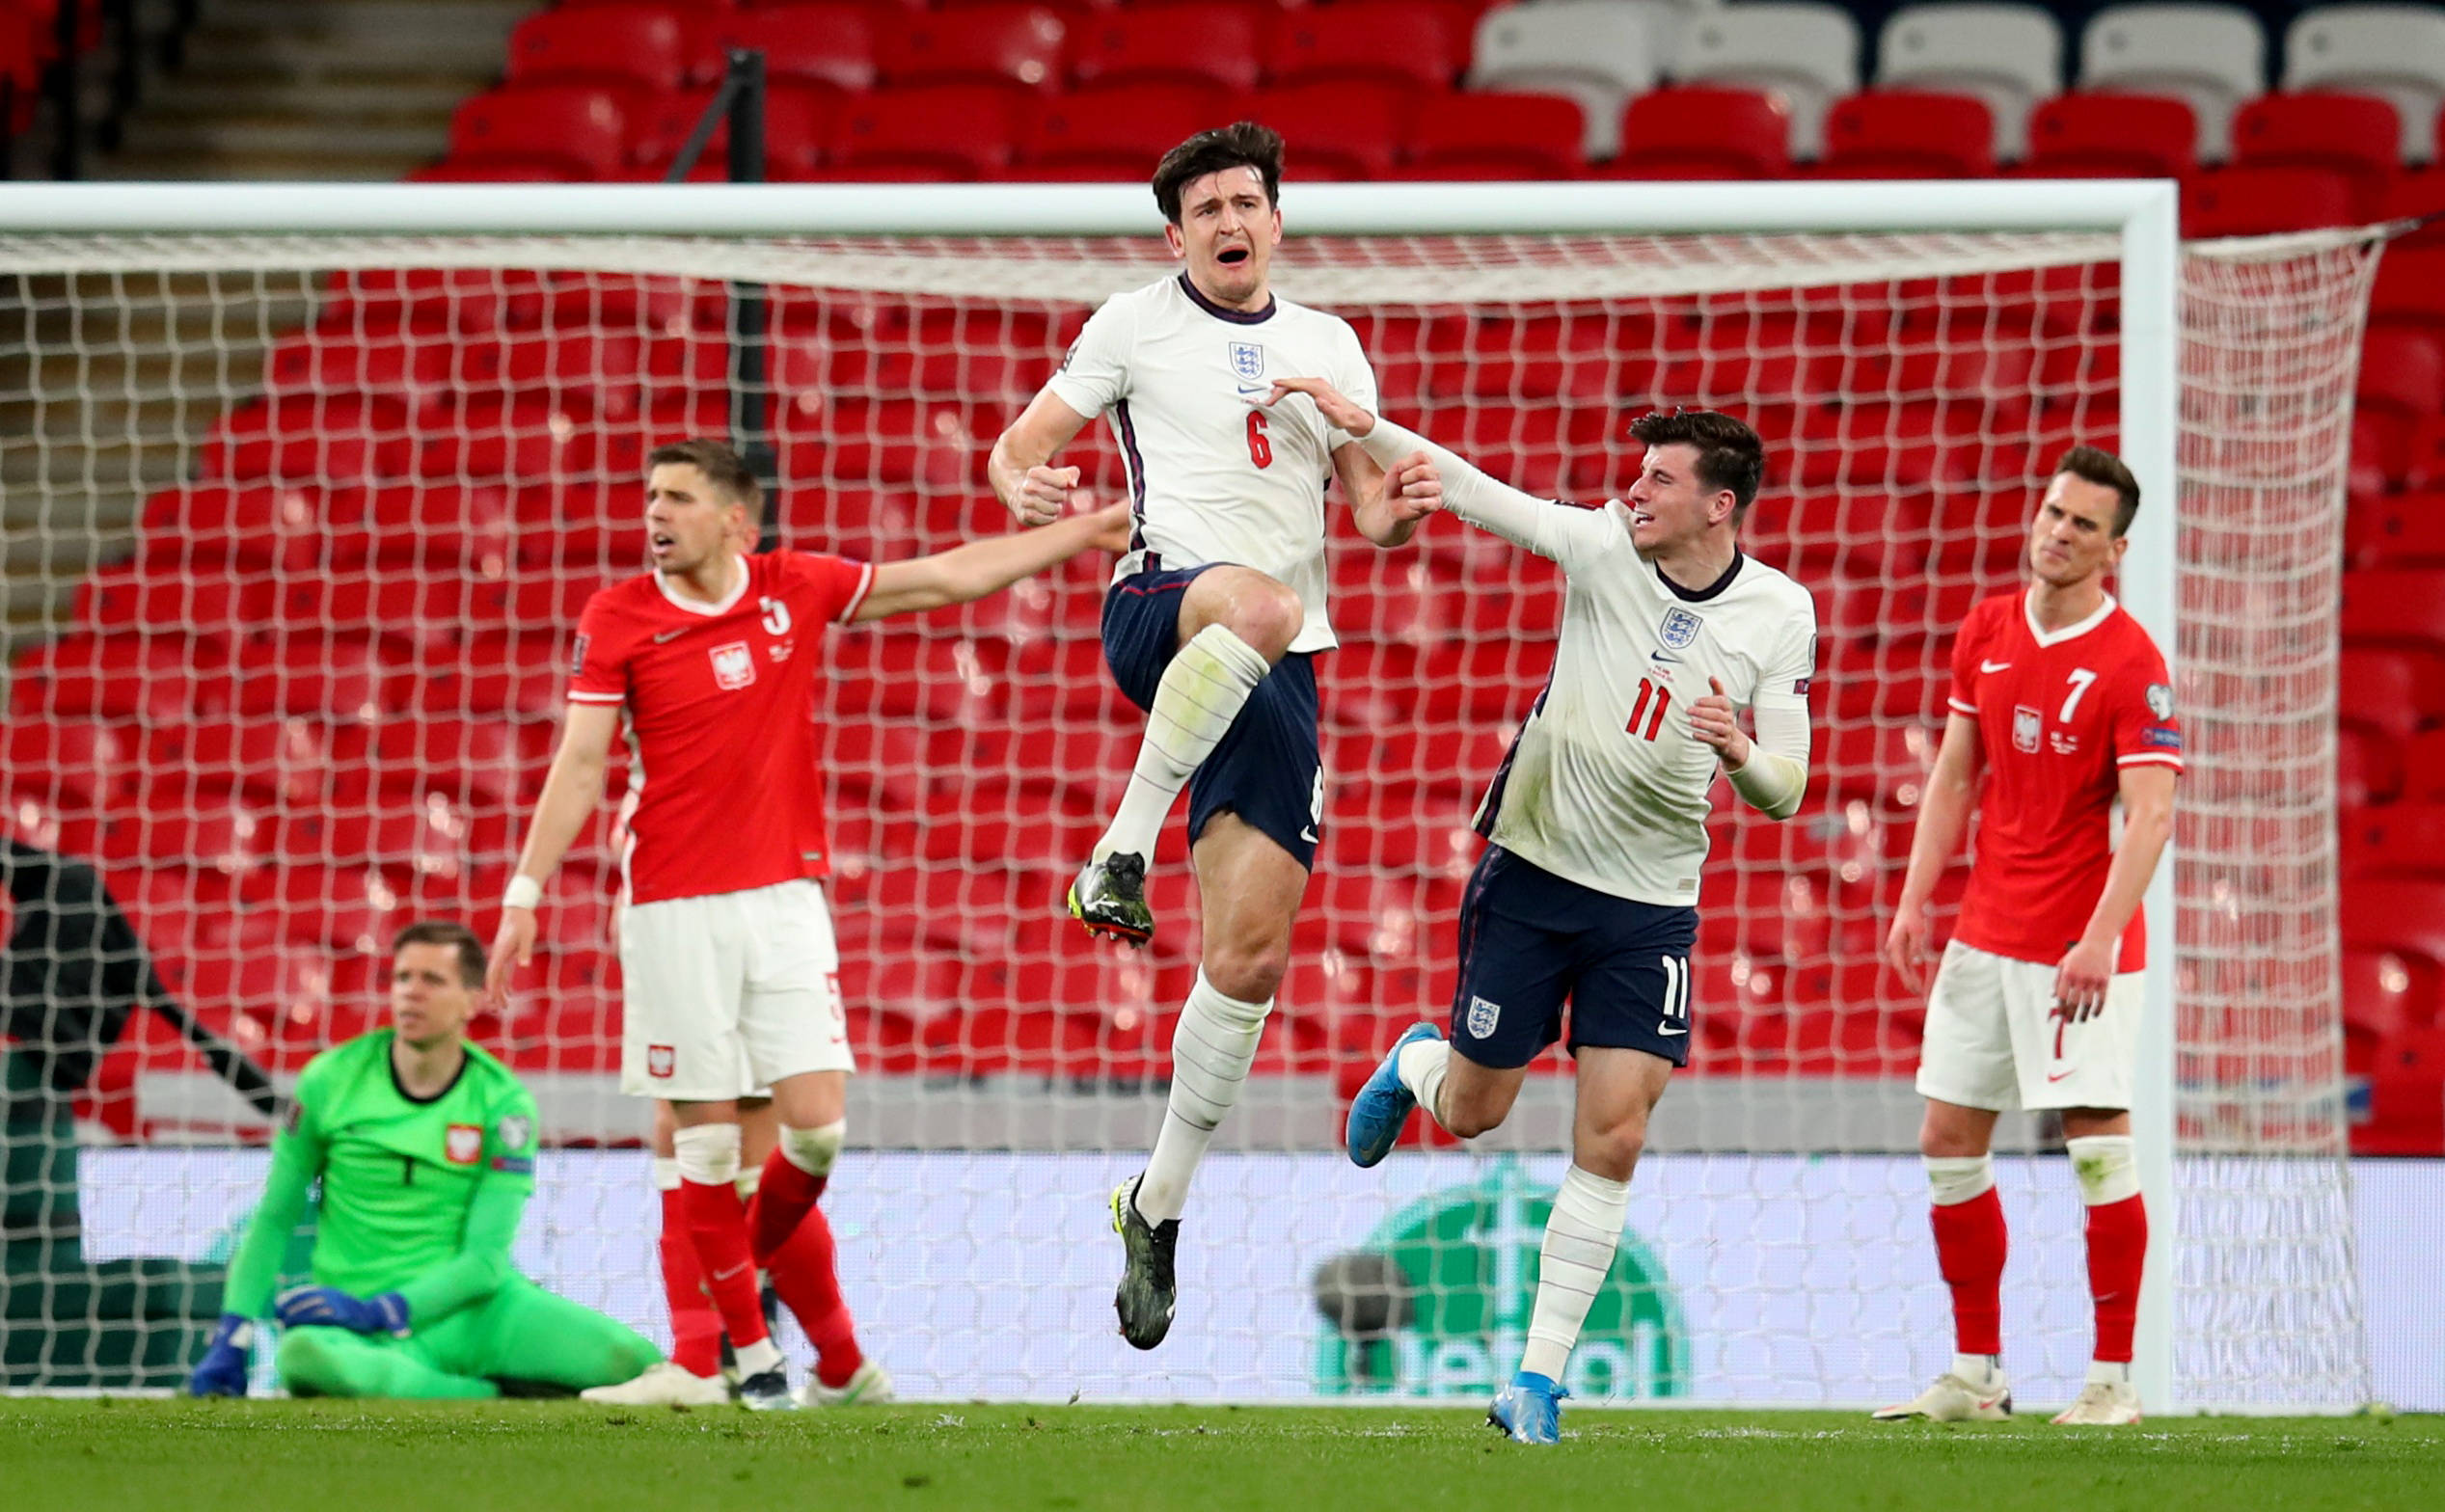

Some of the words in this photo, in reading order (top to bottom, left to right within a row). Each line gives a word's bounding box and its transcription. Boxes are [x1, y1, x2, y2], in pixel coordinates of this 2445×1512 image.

[1246, 410, 1273, 469] 6
[1625, 677, 1671, 742] 11
[2059, 667, 2098, 724] 7
[1661, 955, 1688, 1019] 11
